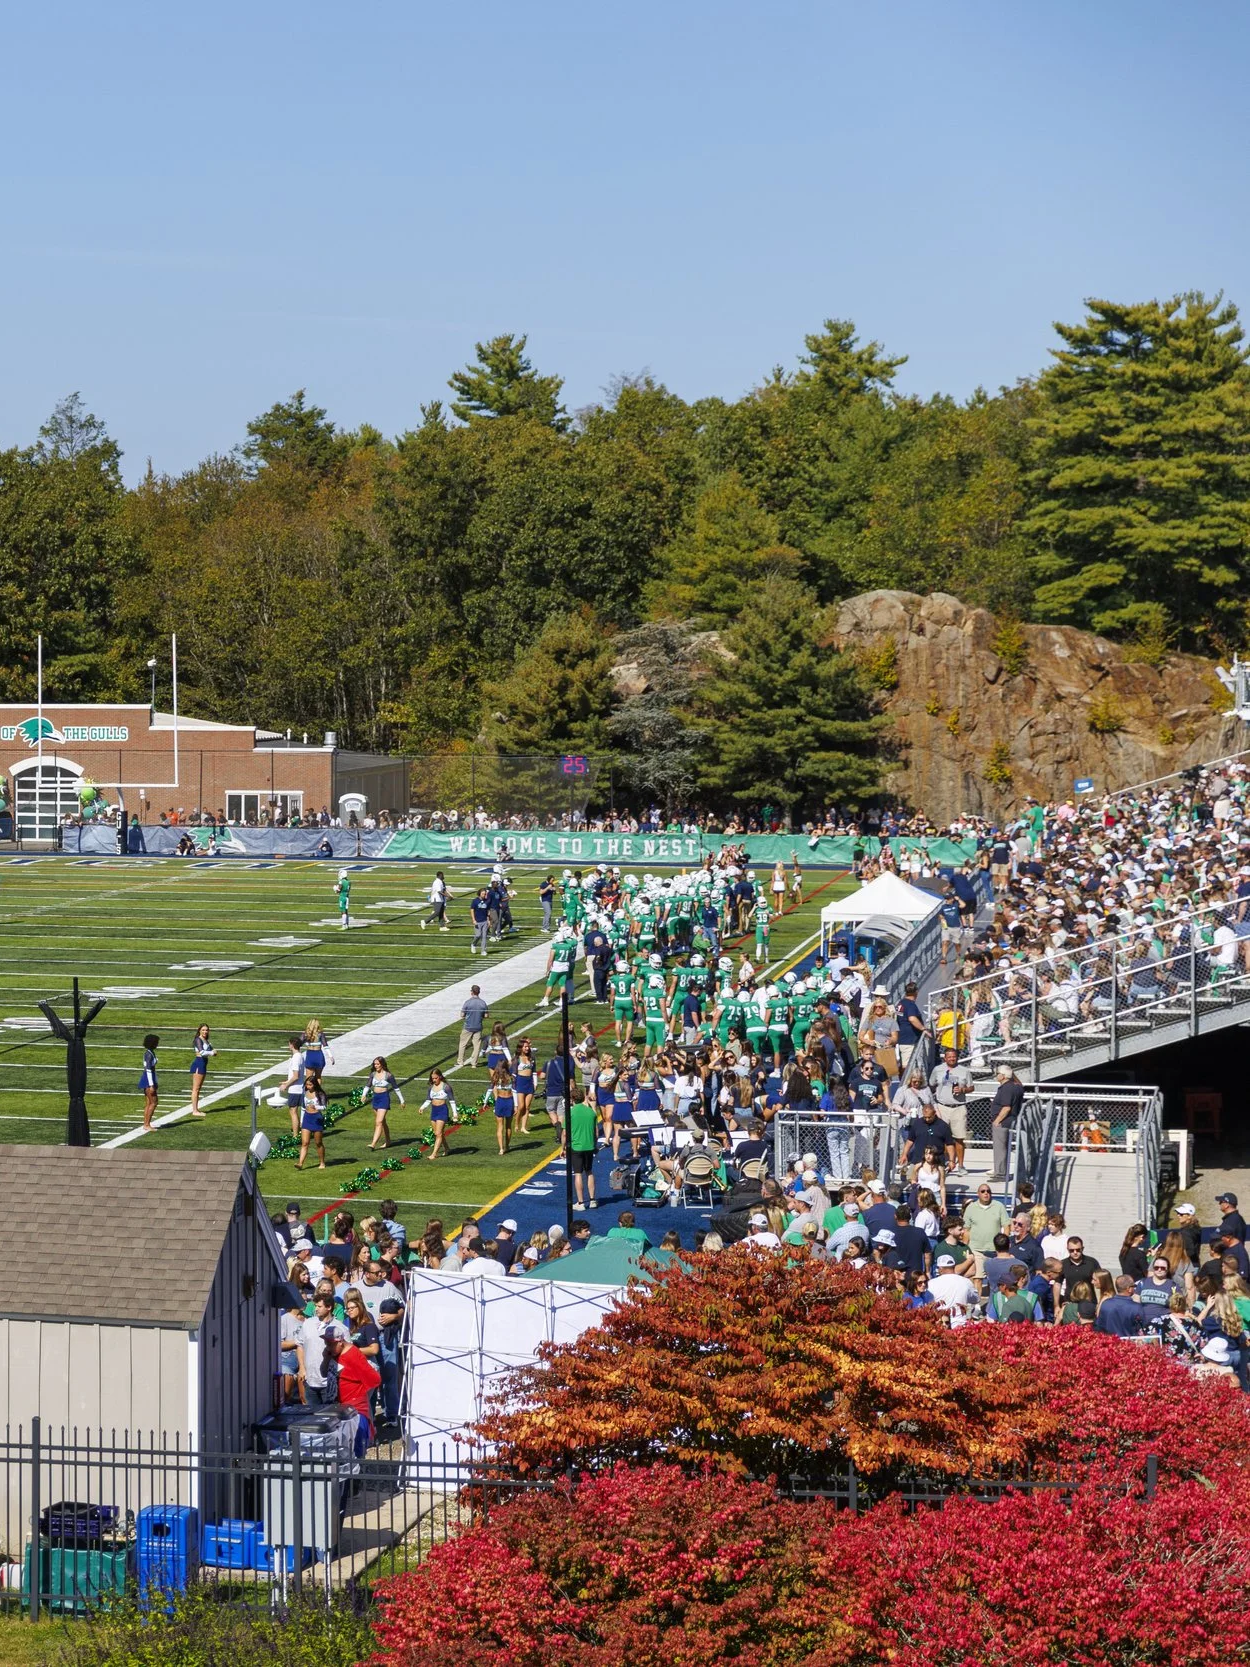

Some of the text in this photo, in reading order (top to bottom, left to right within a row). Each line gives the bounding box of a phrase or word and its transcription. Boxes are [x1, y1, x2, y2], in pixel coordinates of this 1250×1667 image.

[0, 726, 18, 740] OF
[63, 726, 88, 741] THE
[89, 727, 128, 741] GULLS
[563, 757, 585, 774] 25
[449, 836, 697, 857] WELCOME TO THE NEST
[756, 913, 768, 923] 39
[618, 981, 626, 994] 8
[744, 1006, 759, 1019] 79
